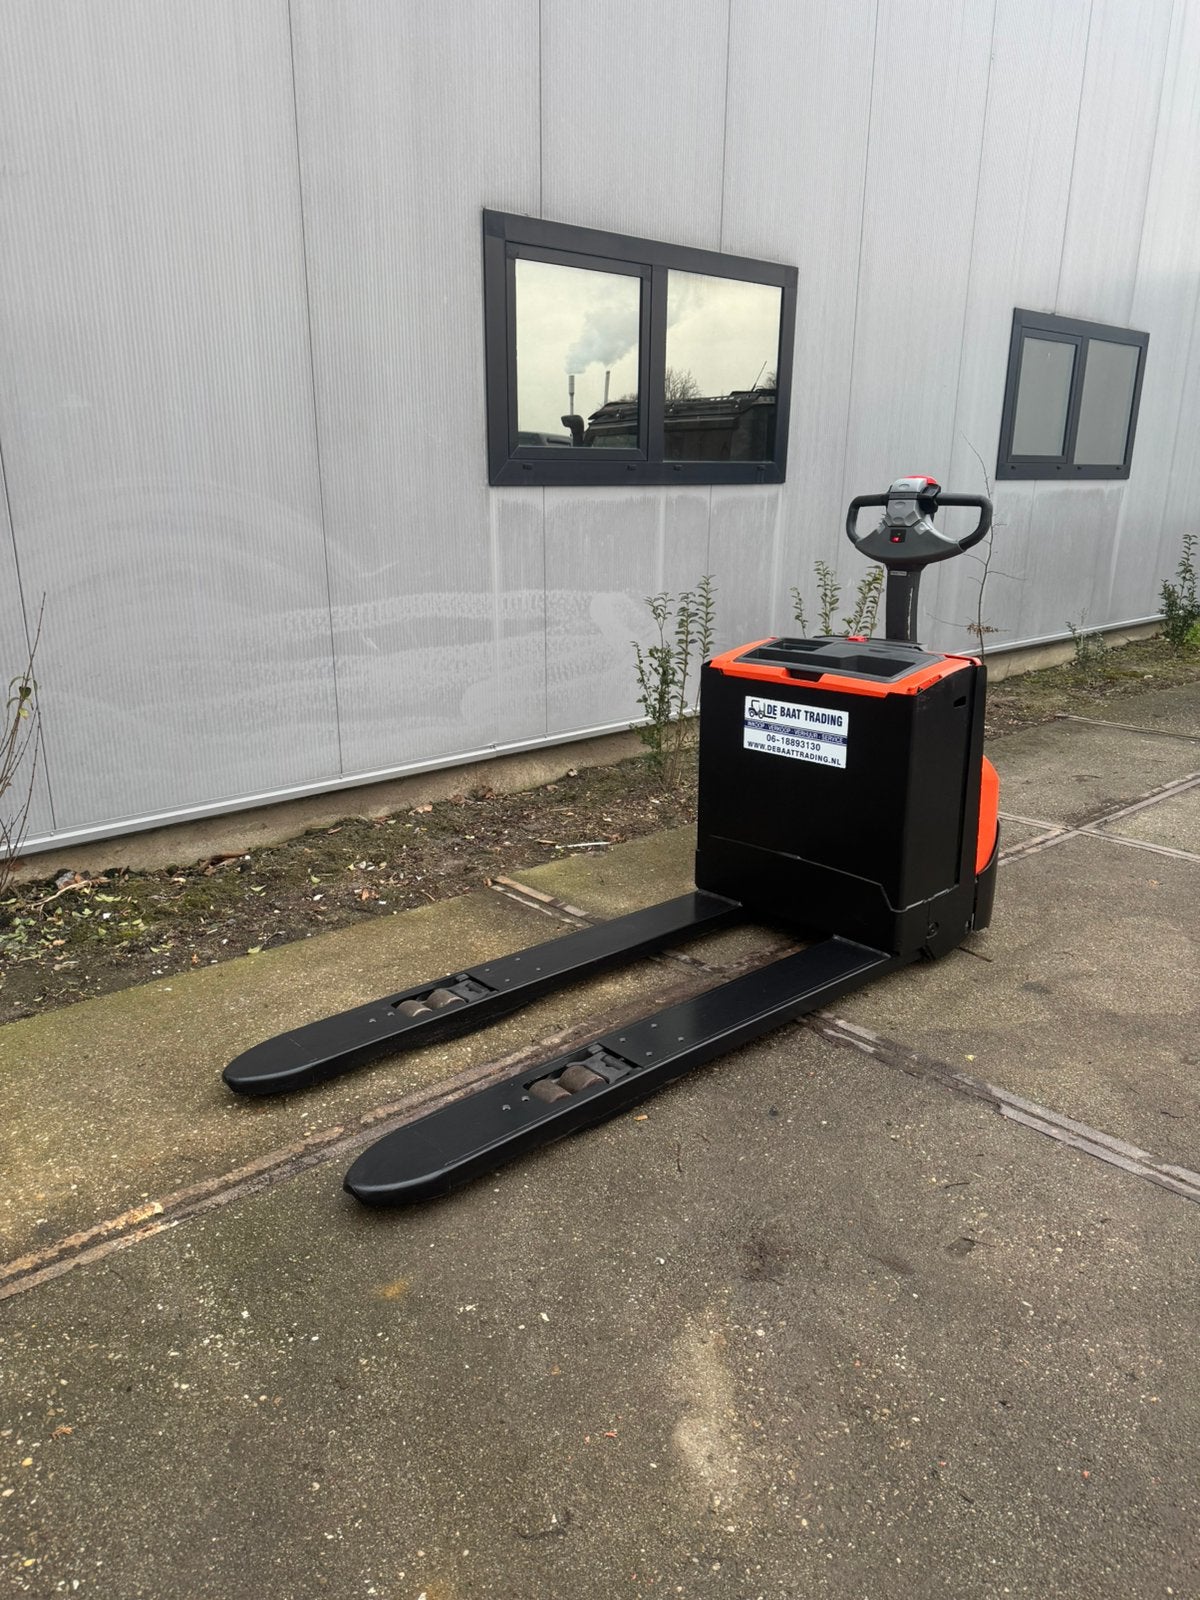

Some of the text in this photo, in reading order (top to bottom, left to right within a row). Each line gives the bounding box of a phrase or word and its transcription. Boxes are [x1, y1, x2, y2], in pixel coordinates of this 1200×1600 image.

[767, 704, 843, 727] DE BAAT TRADING
[747, 741, 841, 766] WWW.DEBAATTRADING.NL
[766, 734, 821, 751] 06-18893130
